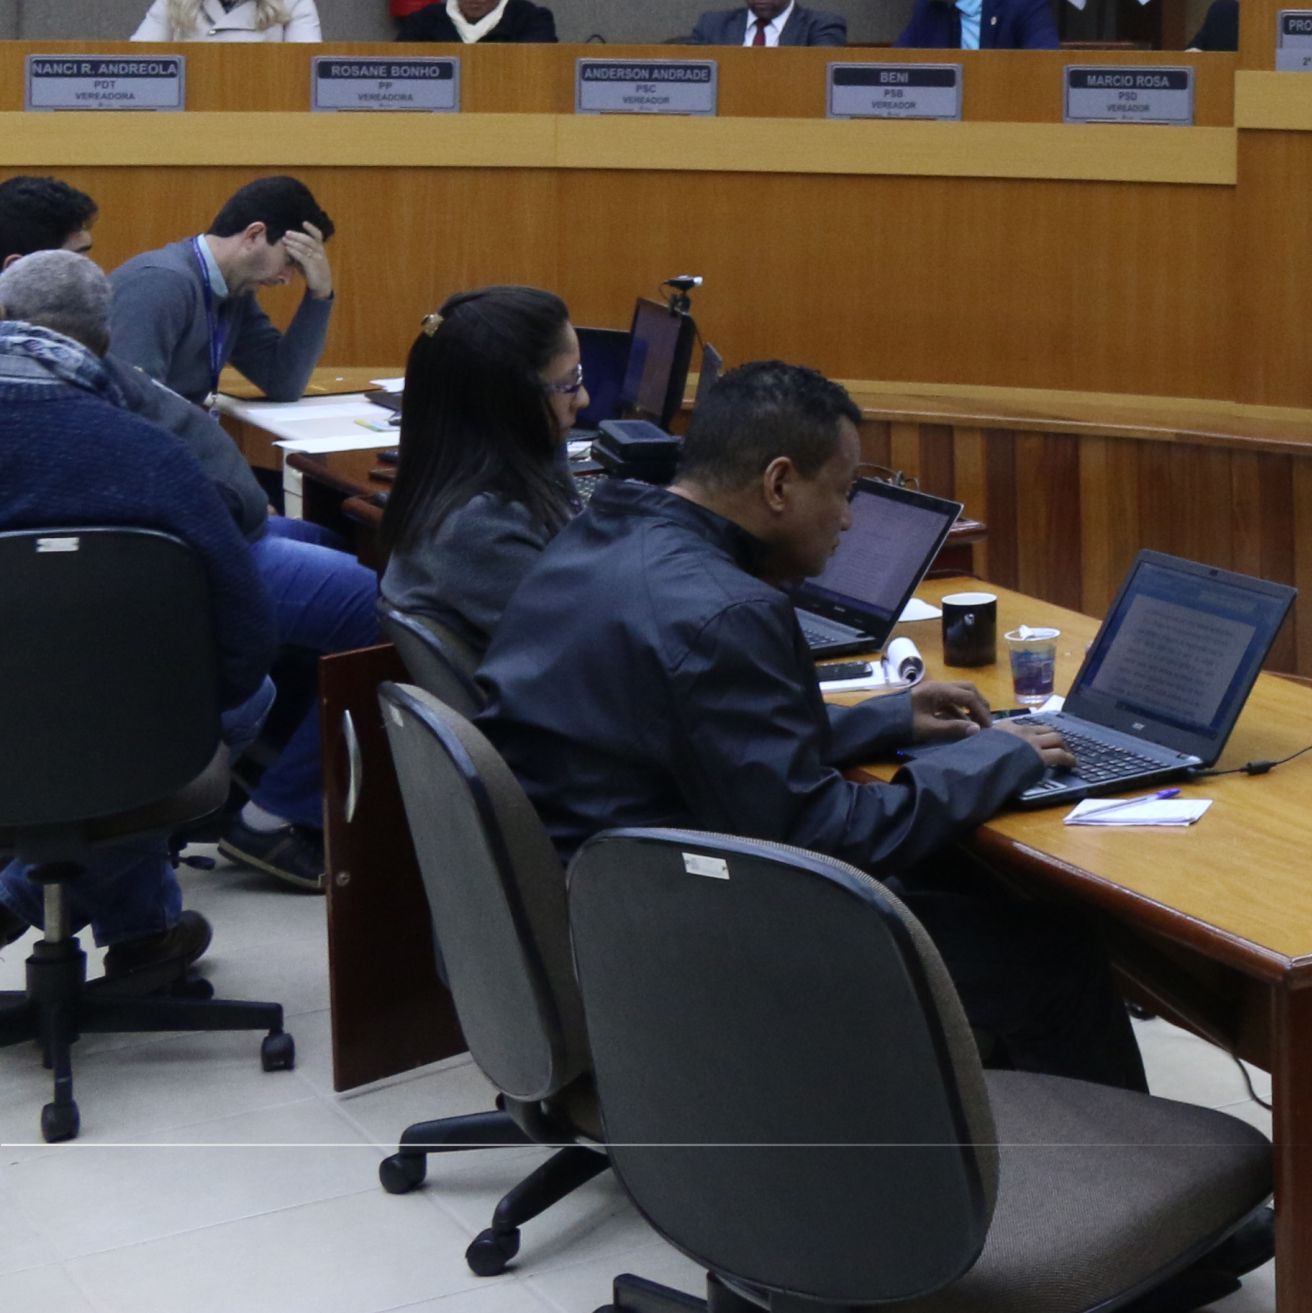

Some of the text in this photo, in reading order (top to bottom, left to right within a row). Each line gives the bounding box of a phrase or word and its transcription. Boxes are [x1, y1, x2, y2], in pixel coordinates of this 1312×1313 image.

[32, 62, 178, 75] NANCI R. ANDREOLA
[331, 66, 440, 78] ROSANE BONHO
[584, 68, 708, 80] ANDERSON ANDRADE
[880, 72, 908, 83] BENI
[1087, 75, 1170, 87] MARCIO ROSA
[94, 80, 116, 90] PDT
